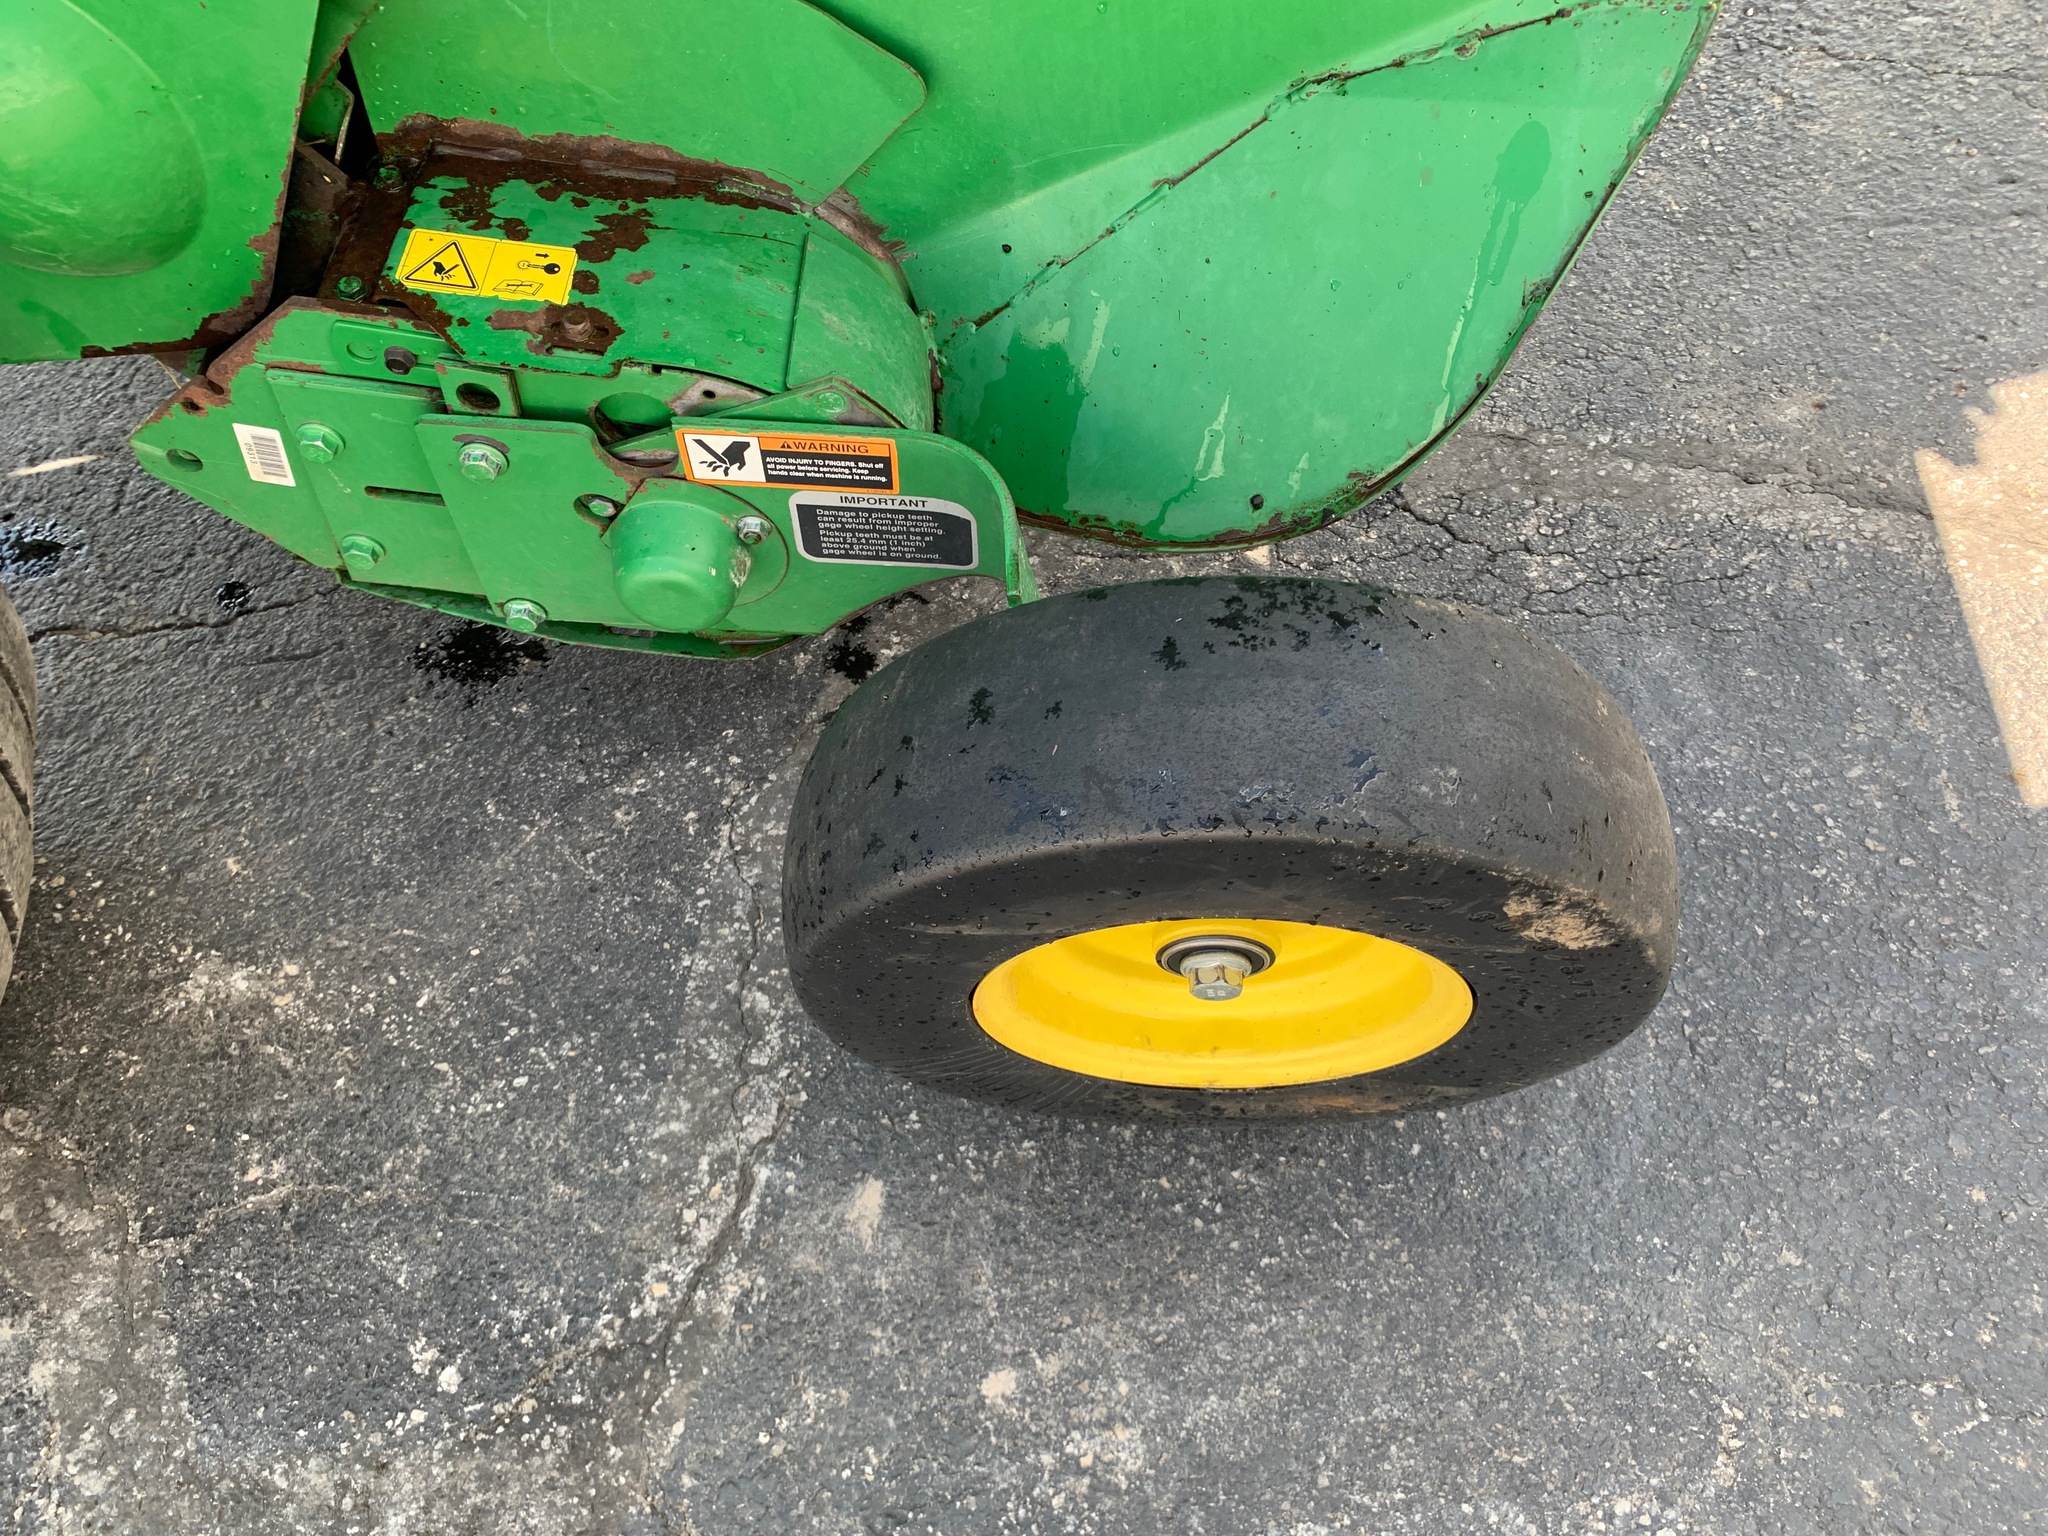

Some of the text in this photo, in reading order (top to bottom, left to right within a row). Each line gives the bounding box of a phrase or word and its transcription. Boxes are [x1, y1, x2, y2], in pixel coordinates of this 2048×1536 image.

[793, 441, 869, 454] WARNING
[820, 466, 851, 474] servicing.
[840, 495, 928, 508] IMPORTANT
[816, 508, 856, 518] Damage
[871, 512, 905, 520] pickup
[894, 519, 939, 527] improper
[819, 529, 853, 538] Pickup
[855, 531, 880, 539] teeth
[875, 524, 907, 532] height
[909, 527, 946, 535] setting.
[820, 535, 844, 543] least
[901, 540, 926, 548] inch)
[822, 548, 846, 556] gage
[904, 552, 942, 560] ground.
